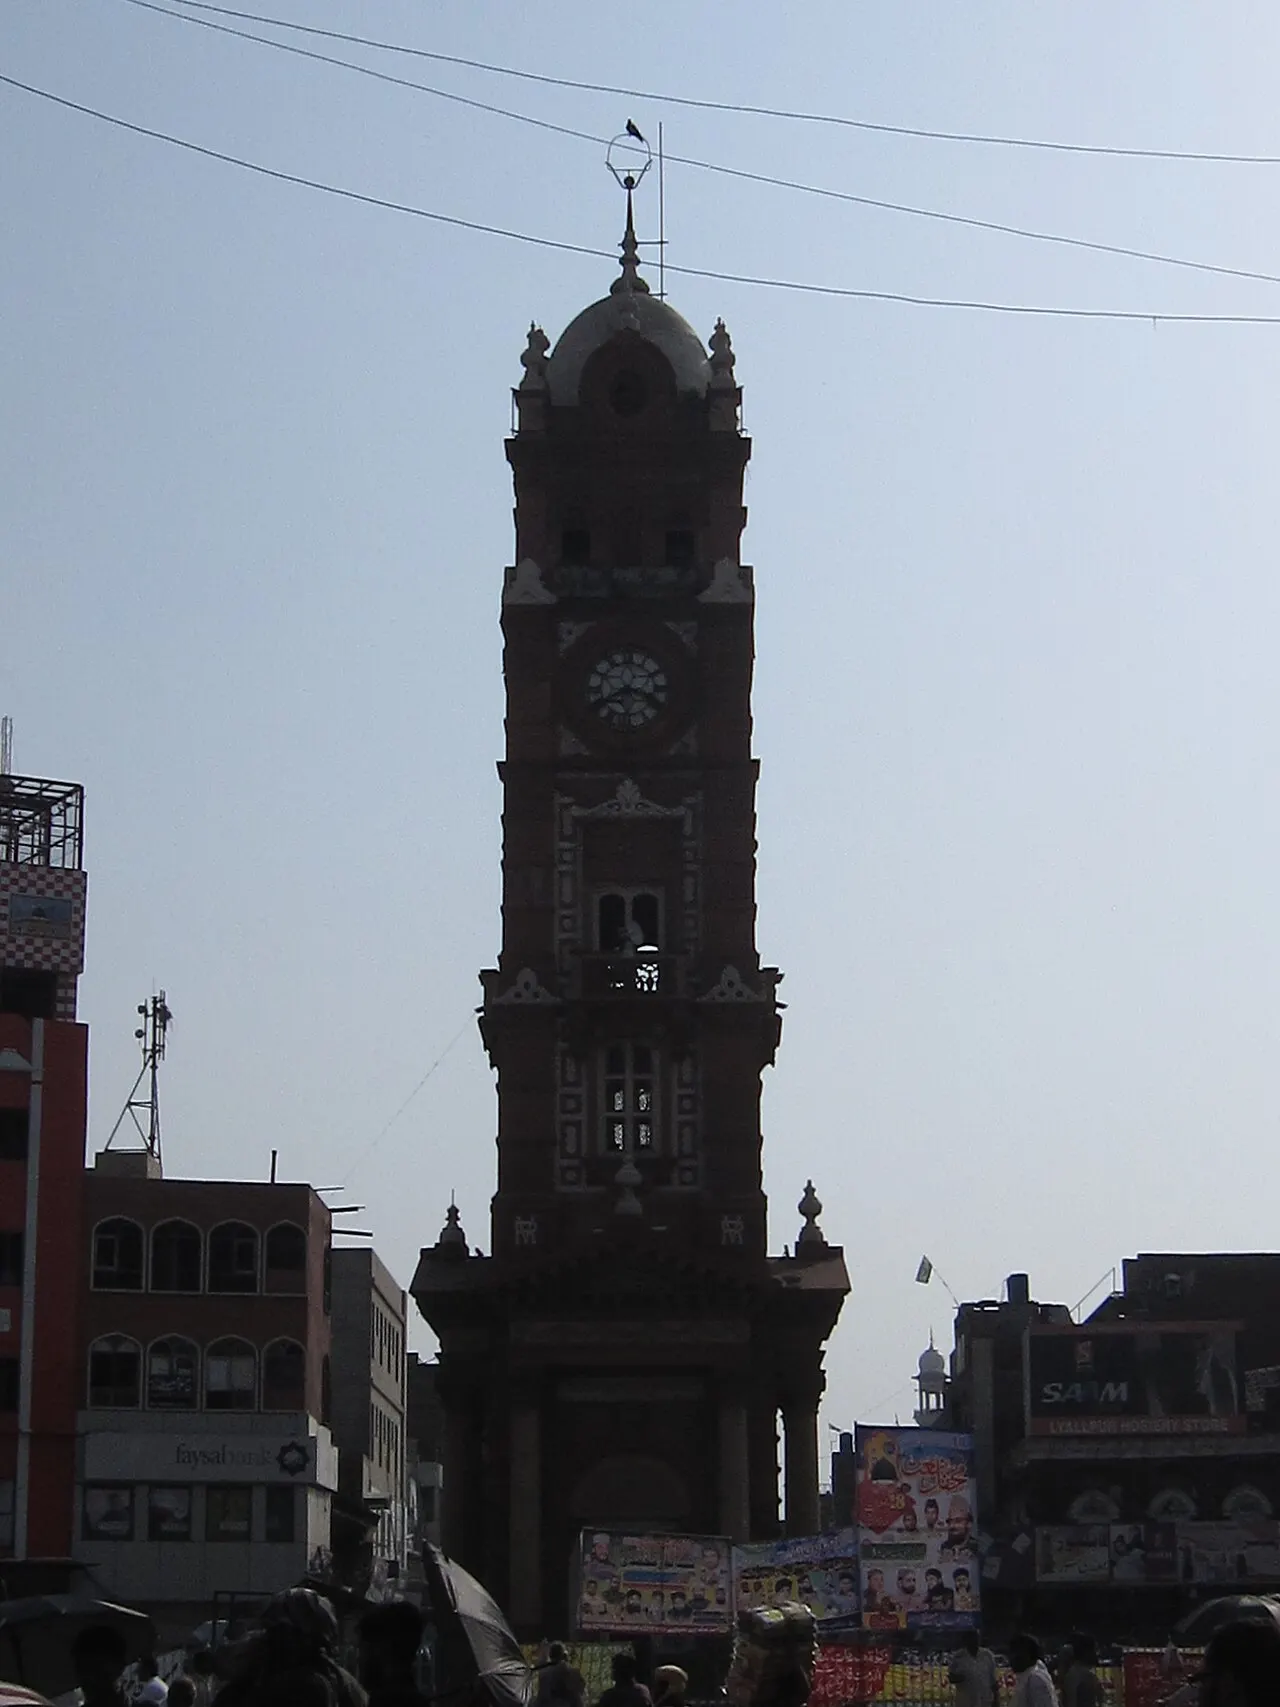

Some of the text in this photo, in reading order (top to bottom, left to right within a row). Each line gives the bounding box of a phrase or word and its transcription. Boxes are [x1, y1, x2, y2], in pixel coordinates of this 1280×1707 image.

[1049, 1417, 1229, 1434] LYALLPUR HOSIERY STORE
